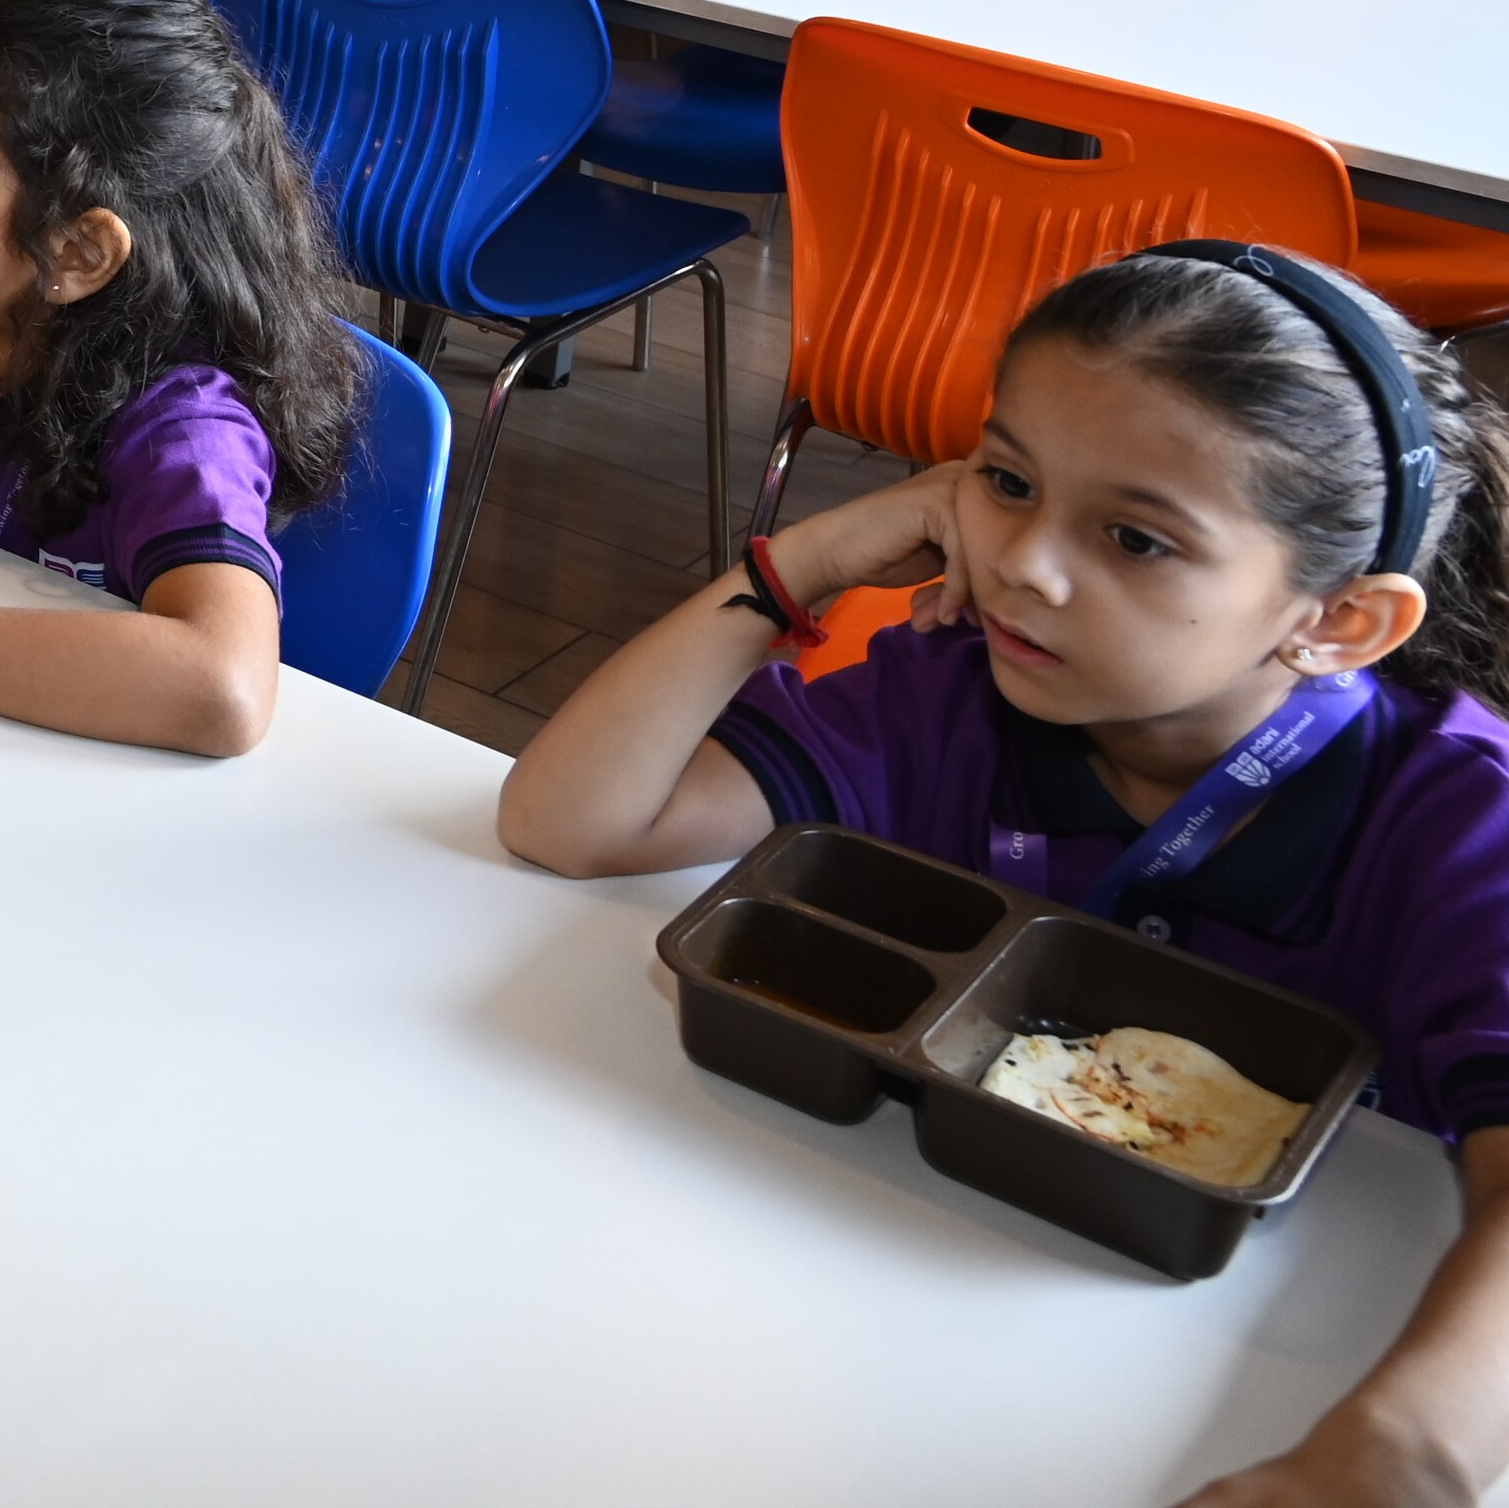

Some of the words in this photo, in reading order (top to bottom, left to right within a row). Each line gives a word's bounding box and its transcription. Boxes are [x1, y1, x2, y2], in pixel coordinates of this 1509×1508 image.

[1249, 726, 1280, 756] adani
[1261, 710, 1316, 763] international
[1272, 743, 1302, 771] school
[1160, 803, 1215, 857] Together
